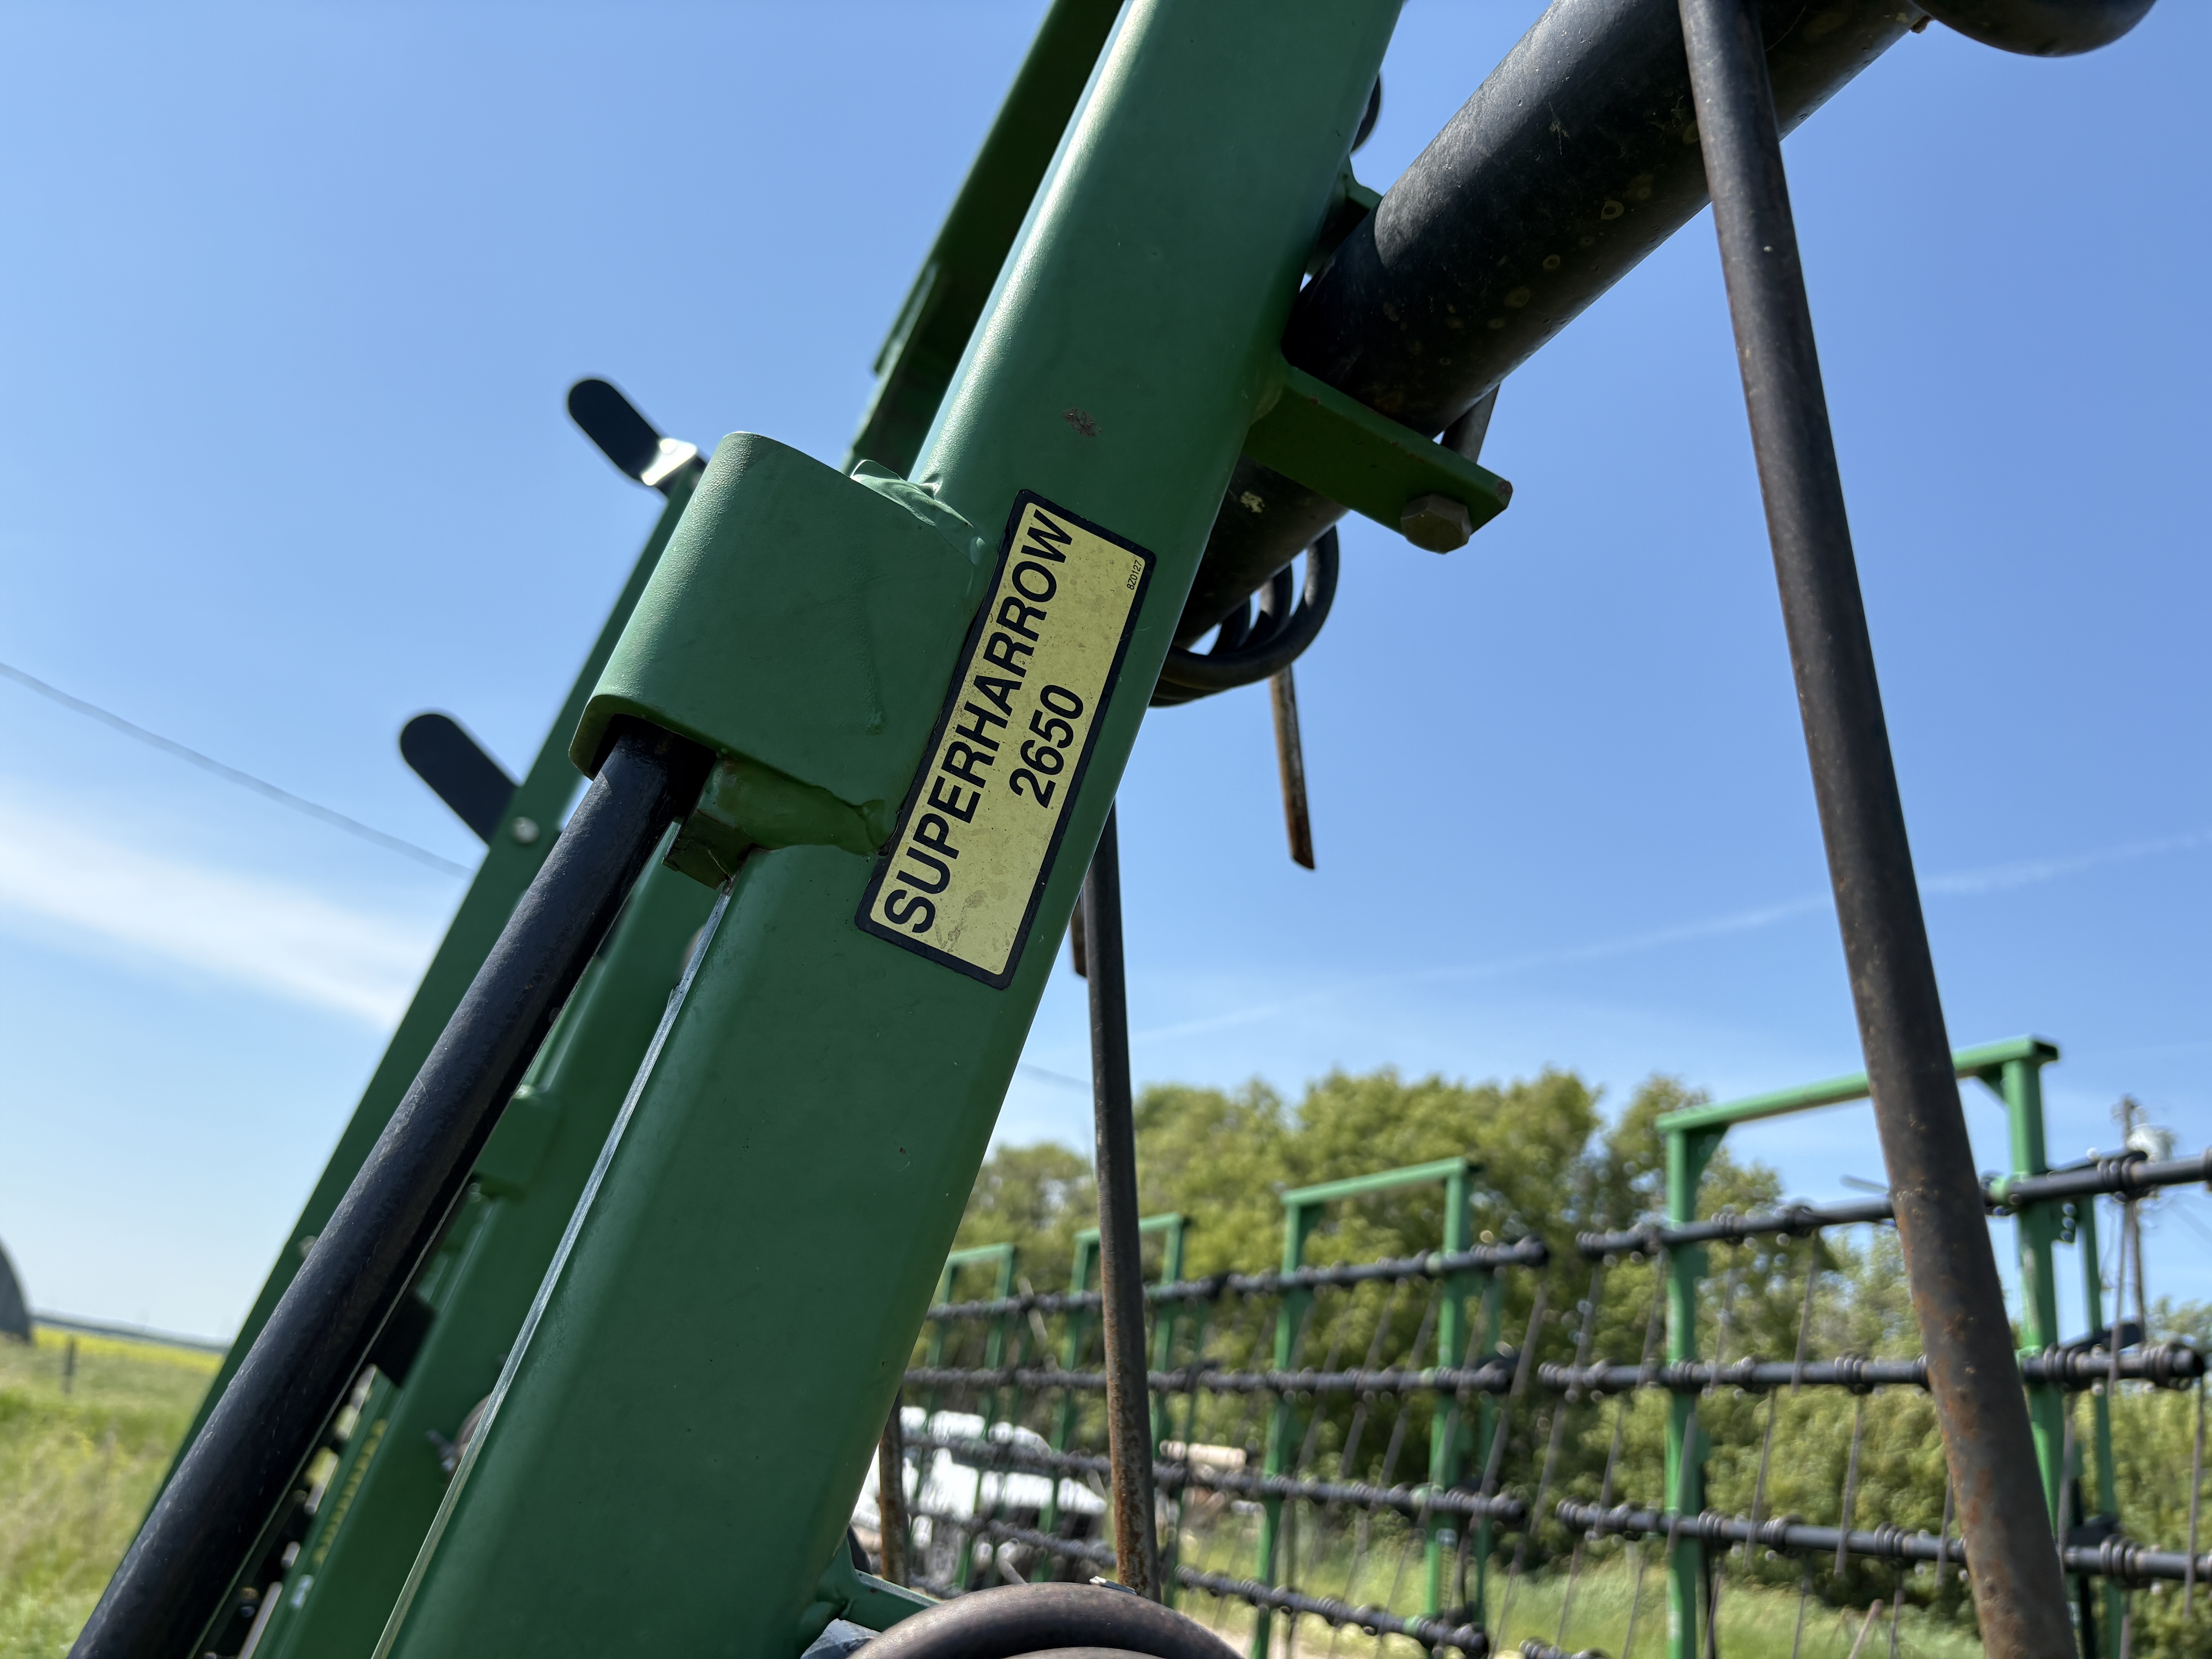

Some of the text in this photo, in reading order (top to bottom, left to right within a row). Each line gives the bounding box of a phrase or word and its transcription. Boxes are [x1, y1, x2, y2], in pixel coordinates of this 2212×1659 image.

[1127, 559, 1142, 590] 8Z0127
[884, 508, 1073, 933] SUPERHARROW
[1009, 685, 1084, 809] 2650
